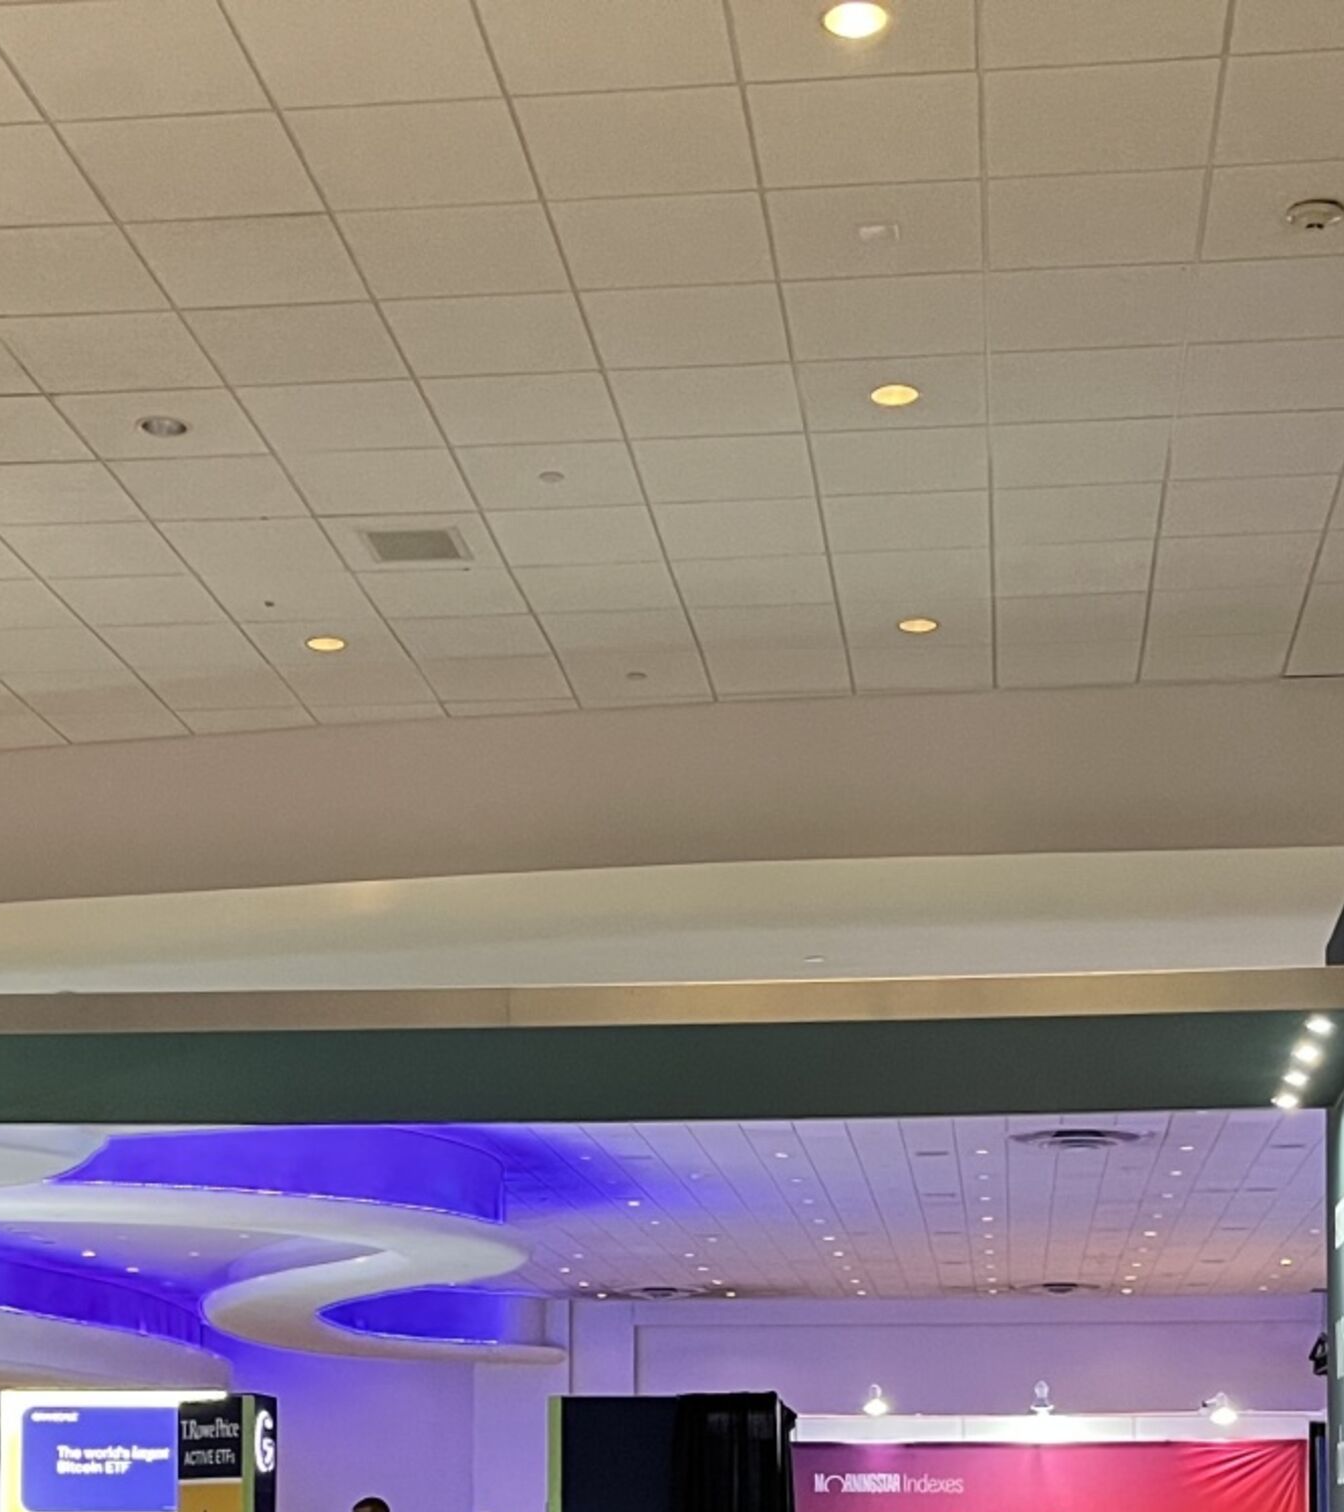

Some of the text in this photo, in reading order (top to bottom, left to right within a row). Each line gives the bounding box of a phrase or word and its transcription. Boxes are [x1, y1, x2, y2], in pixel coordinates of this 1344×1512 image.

[57, 1445, 82, 1460] The
[83, 1445, 131, 1460] world's
[184, 1449, 214, 1466] ACTIVE
[56, 1460, 133, 1475] Bitcoin ETF
[814, 1473, 964, 1494] MORNINGSTAR Indexes
